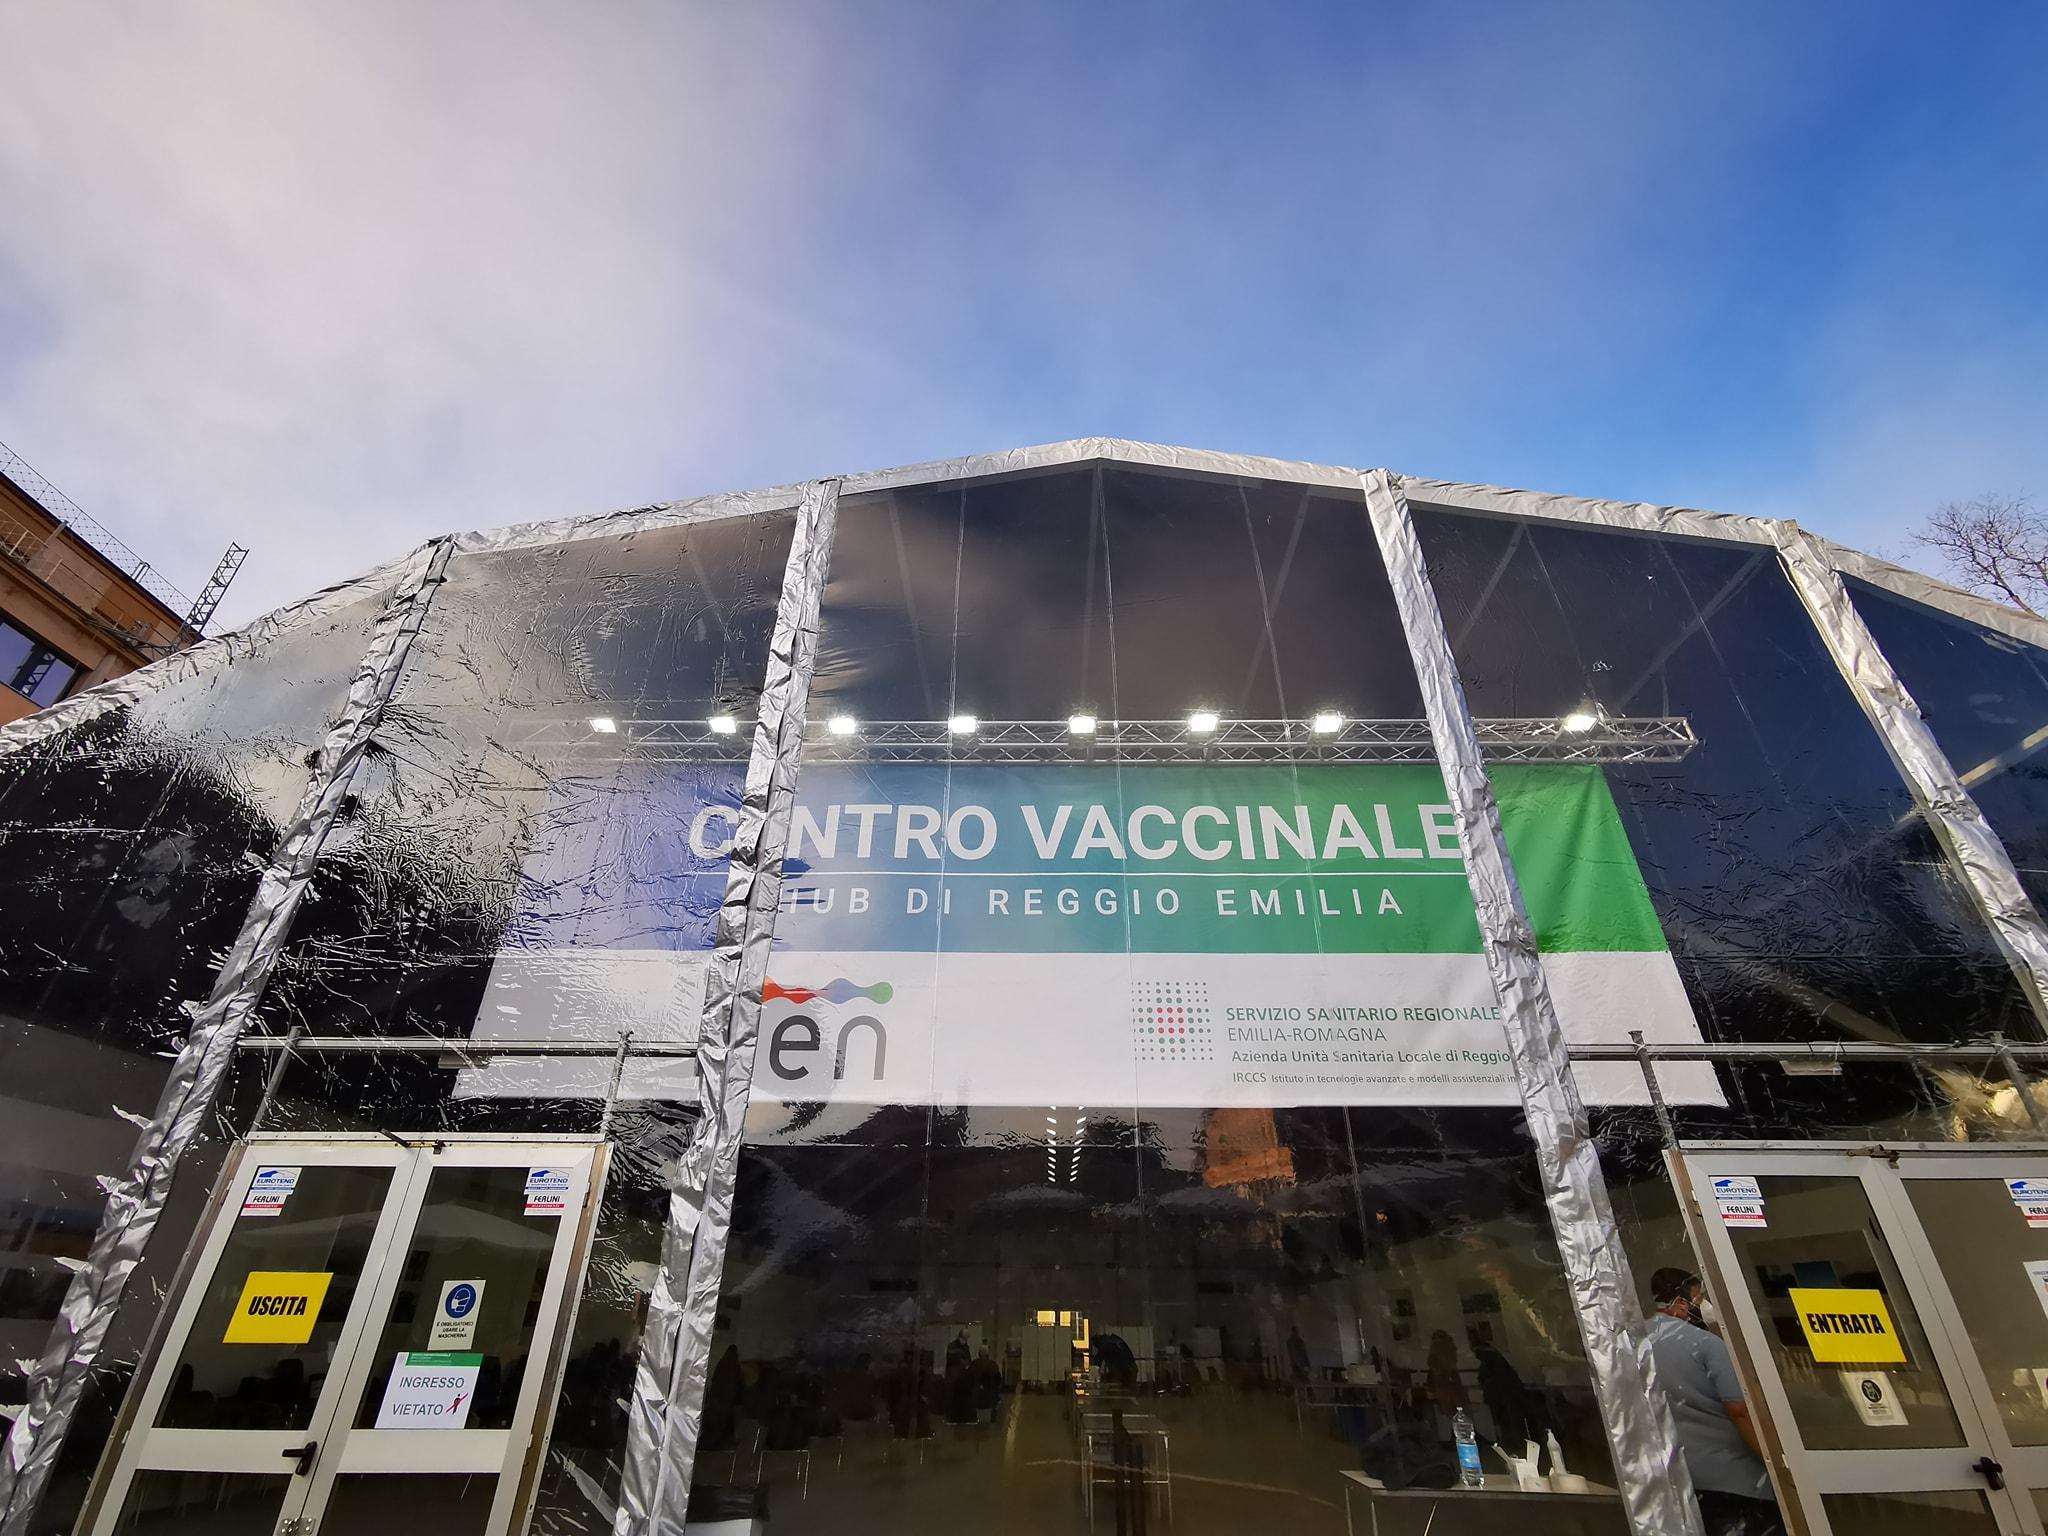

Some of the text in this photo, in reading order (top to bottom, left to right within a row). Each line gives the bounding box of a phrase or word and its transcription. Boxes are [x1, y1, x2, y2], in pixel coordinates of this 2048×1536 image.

[688, 803, 1464, 861] CNTRO VACCINALE
[906, 888, 951, 915] DI
[987, 888, 1181, 916] REGGIO
[1215, 888, 1404, 916] EMILIA
[1225, 1006, 1501, 1021] SERVIZIO SANITARIO REGIONALE
[1228, 1027, 1388, 1042] EMILIA-ROMAGNA
[1231, 1049, 1511, 1065] Azienda Unità Sanitaria Locale di Reggio
[1232, 1072, 1267, 1083] IRCCS
[1271, 1074, 1304, 1084] Istituto
[1306, 1074, 1315, 1083] in
[1317, 1074, 1364, 1086] tecnologie
[1366, 1076, 1407, 1084] avanzate
[1409, 1076, 1415, 1084] e
[1417, 1074, 1450, 1084] modelli
[1452, 1074, 1506, 1084] assistenziali
[247, 1295, 308, 1316] USCITA
[1805, 1312, 1887, 1334] ENTRATA
[399, 1376, 465, 1389] INGRESSO
[392, 1403, 444, 1416] VIETATO
